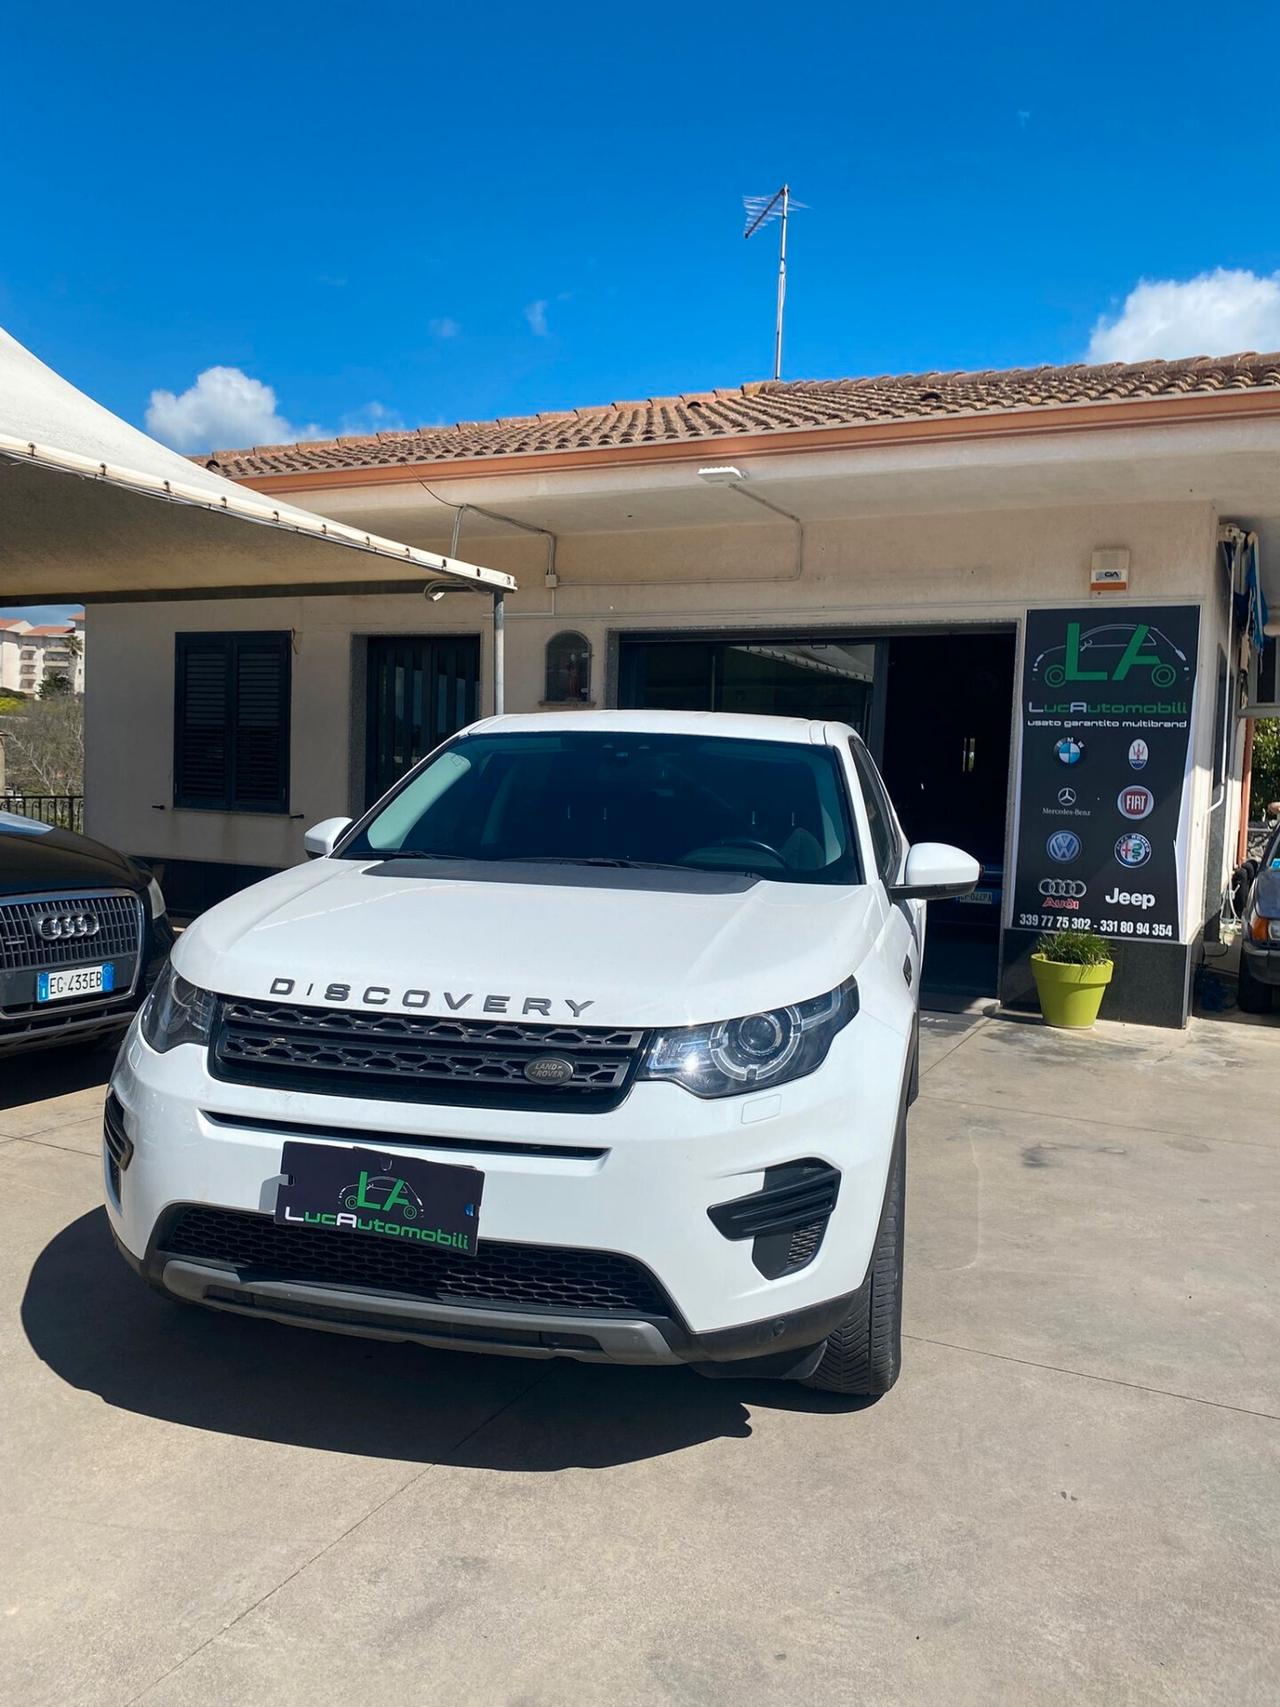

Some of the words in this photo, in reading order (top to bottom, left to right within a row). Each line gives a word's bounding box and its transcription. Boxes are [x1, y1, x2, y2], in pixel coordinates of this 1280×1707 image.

[1029, 702, 1187, 714] LucAutomobili
[1027, 719, 1061, 727] usato
[1063, 719, 1119, 729] garantito
[1122, 719, 1187, 729] multibrand
[1042, 807, 1091, 816] Mercedes-Benz
[1126, 794, 1147, 812] FIAT
[1042, 897, 1079, 909] Audi
[1105, 888, 1156, 909] Jeep
[1019, 914, 1038, 926] 339
[1041, 915, 1054, 927] 77
[1056, 916, 1069, 928] 75
[1071, 917, 1091, 930] 302
[1100, 919, 1119, 932] 331
[1120, 921, 1133, 933] 80
[1136, 922, 1150, 935] 94
[1152, 924, 1173, 936] 354
[50, 976, 64, 994] EG
[269, 977, 595, 1018] DISCOVERY
[536, 1070, 564, 1078] ROVER
[285, 1206, 469, 1250] LucAutomobili
